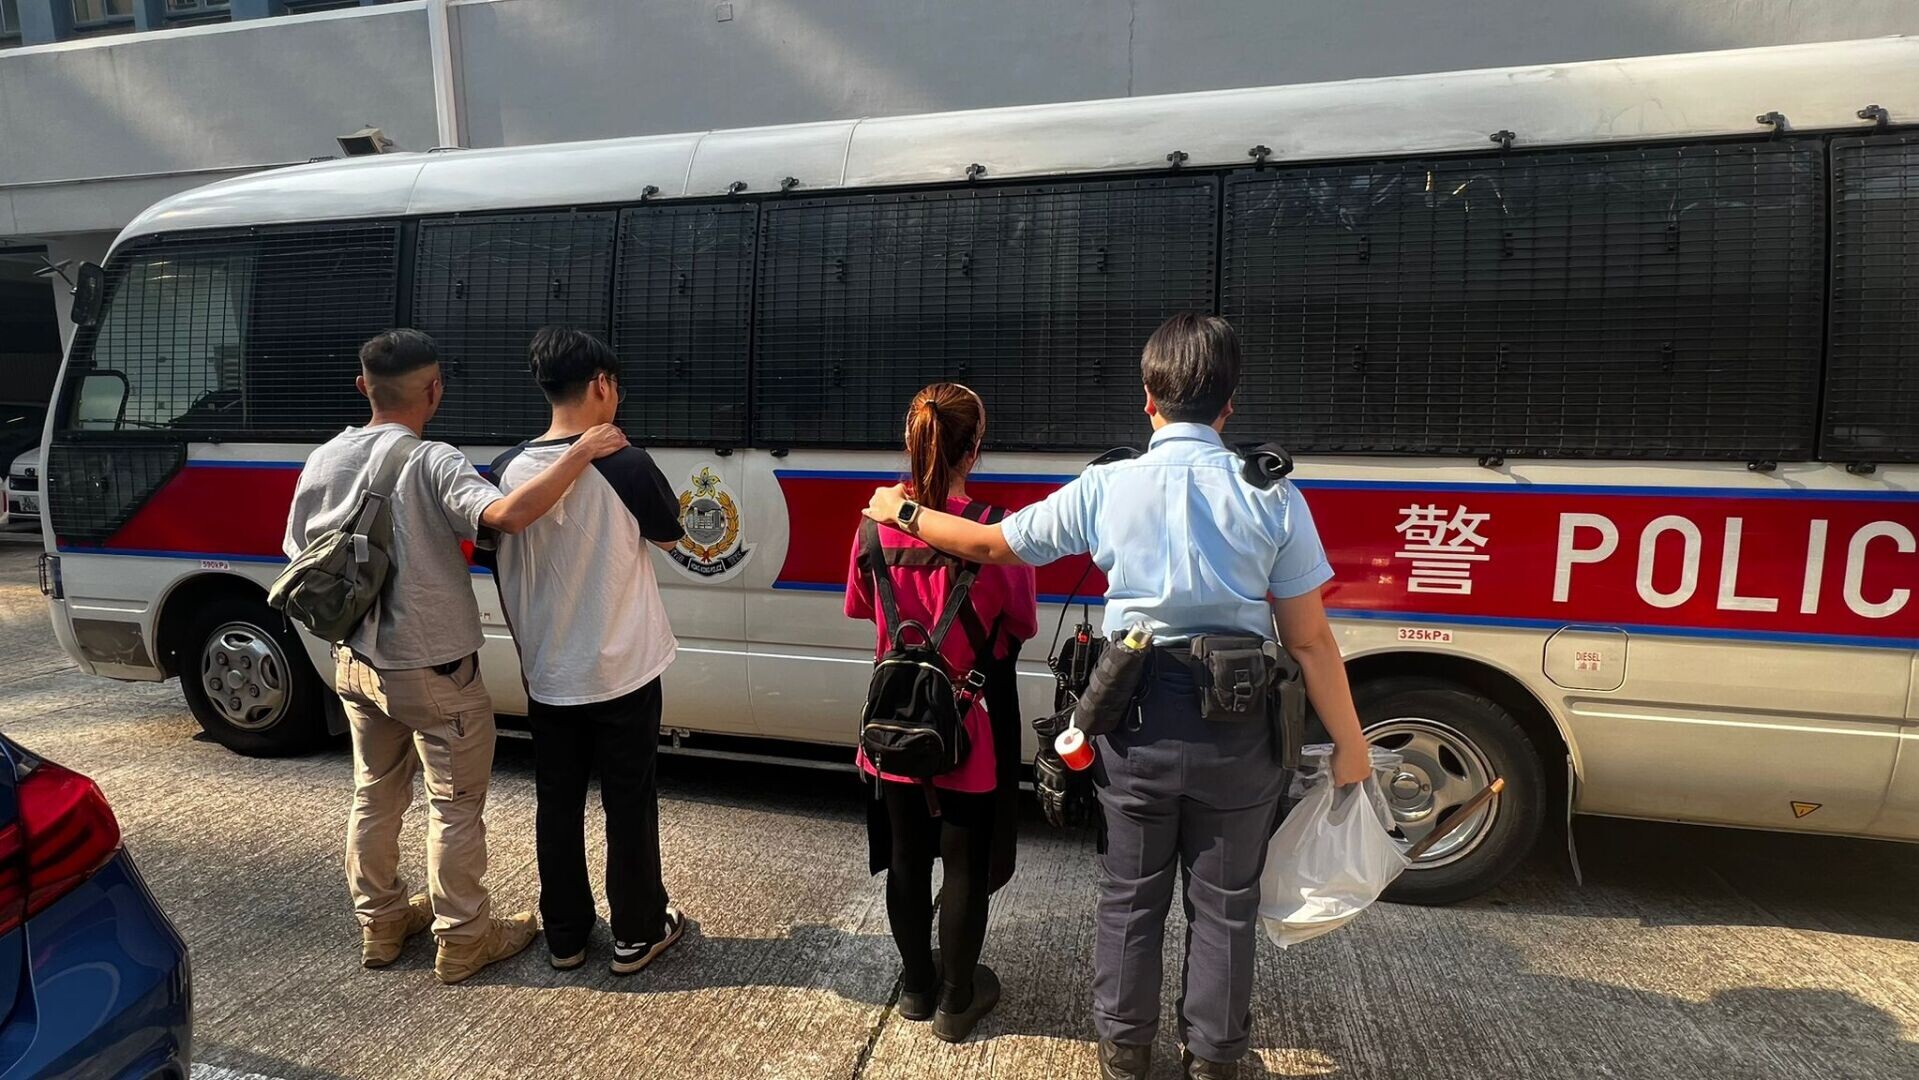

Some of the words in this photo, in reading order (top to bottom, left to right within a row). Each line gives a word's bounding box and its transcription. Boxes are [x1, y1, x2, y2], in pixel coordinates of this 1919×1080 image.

[1395, 504, 1490, 594] 警
[1552, 512, 1917, 619] POLIC
[1400, 629, 1450, 641] 325kPa
[1576, 651, 1600, 661] DIESEL
